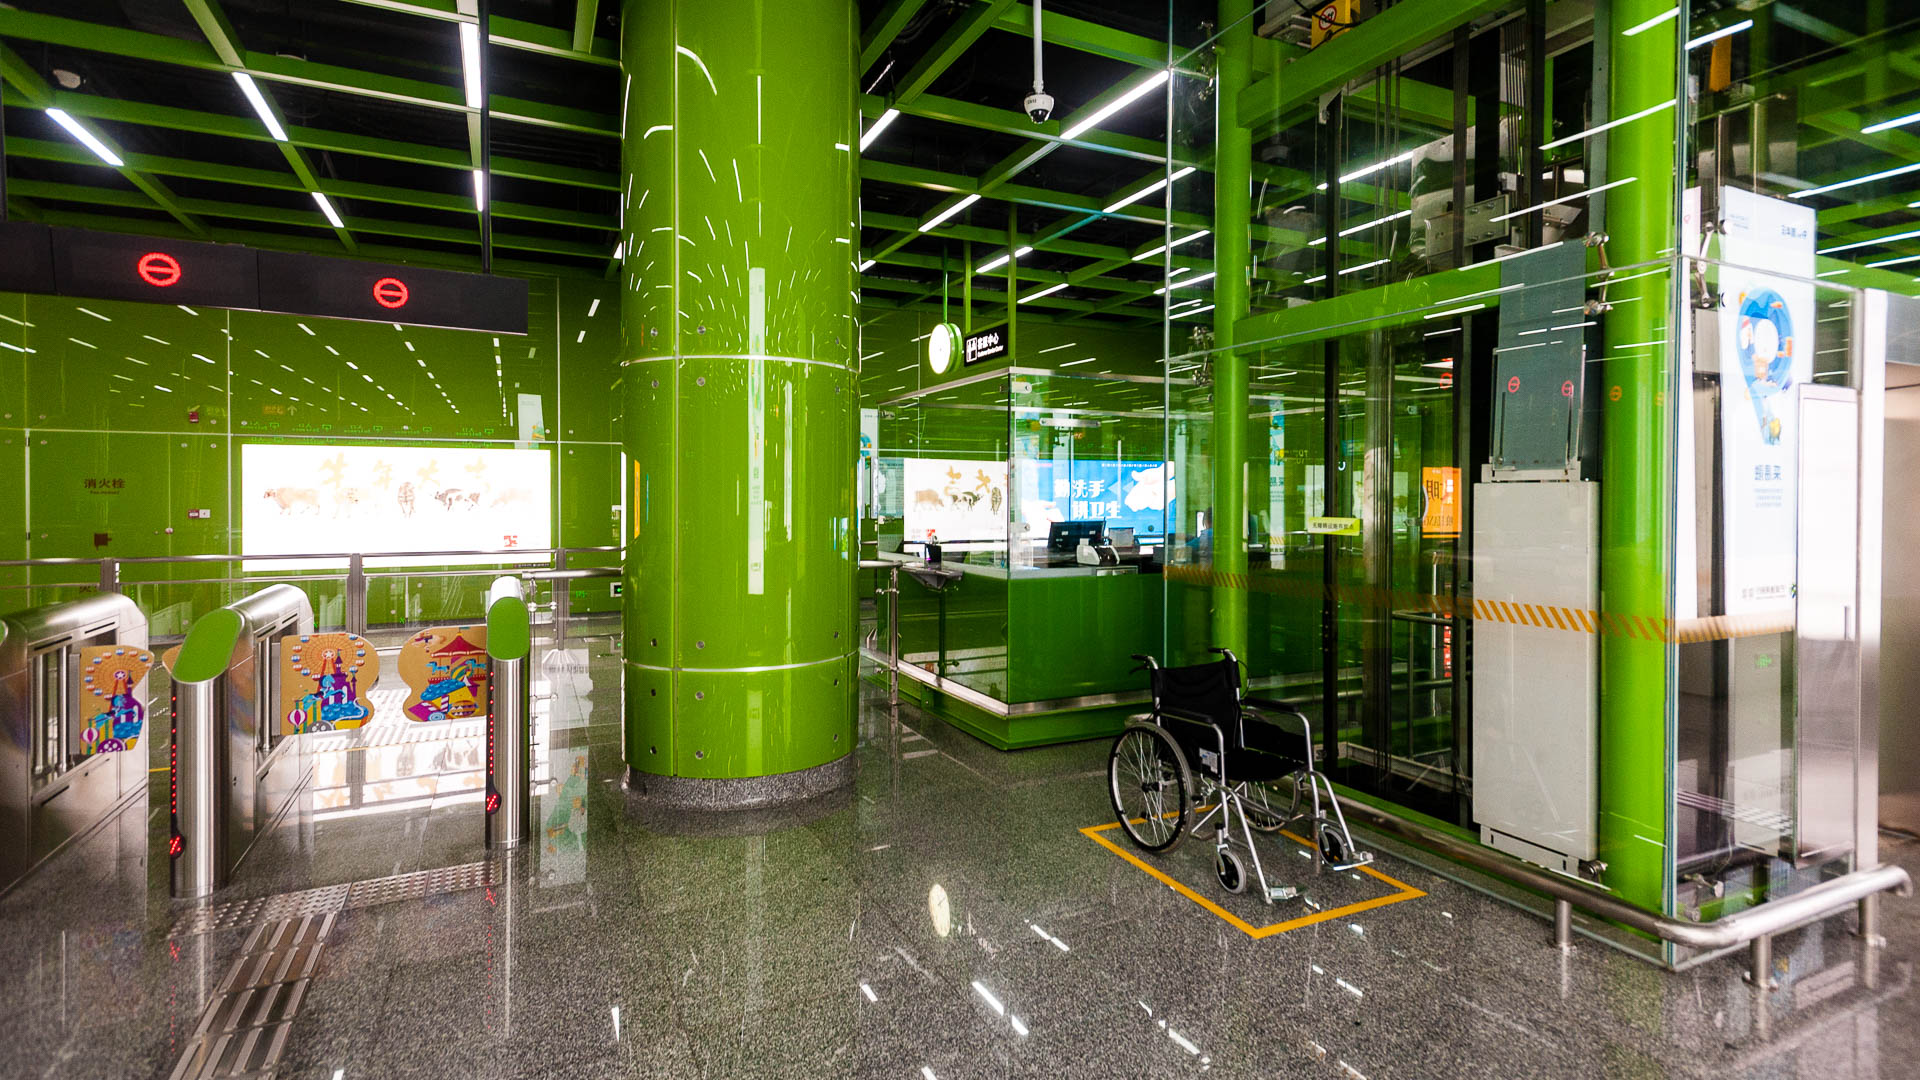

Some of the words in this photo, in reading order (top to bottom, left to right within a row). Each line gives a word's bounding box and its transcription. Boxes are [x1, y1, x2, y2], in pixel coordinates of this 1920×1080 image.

[84, 478, 126, 489] 消火栓
[1072, 501, 1122, 519] 讲卫生
